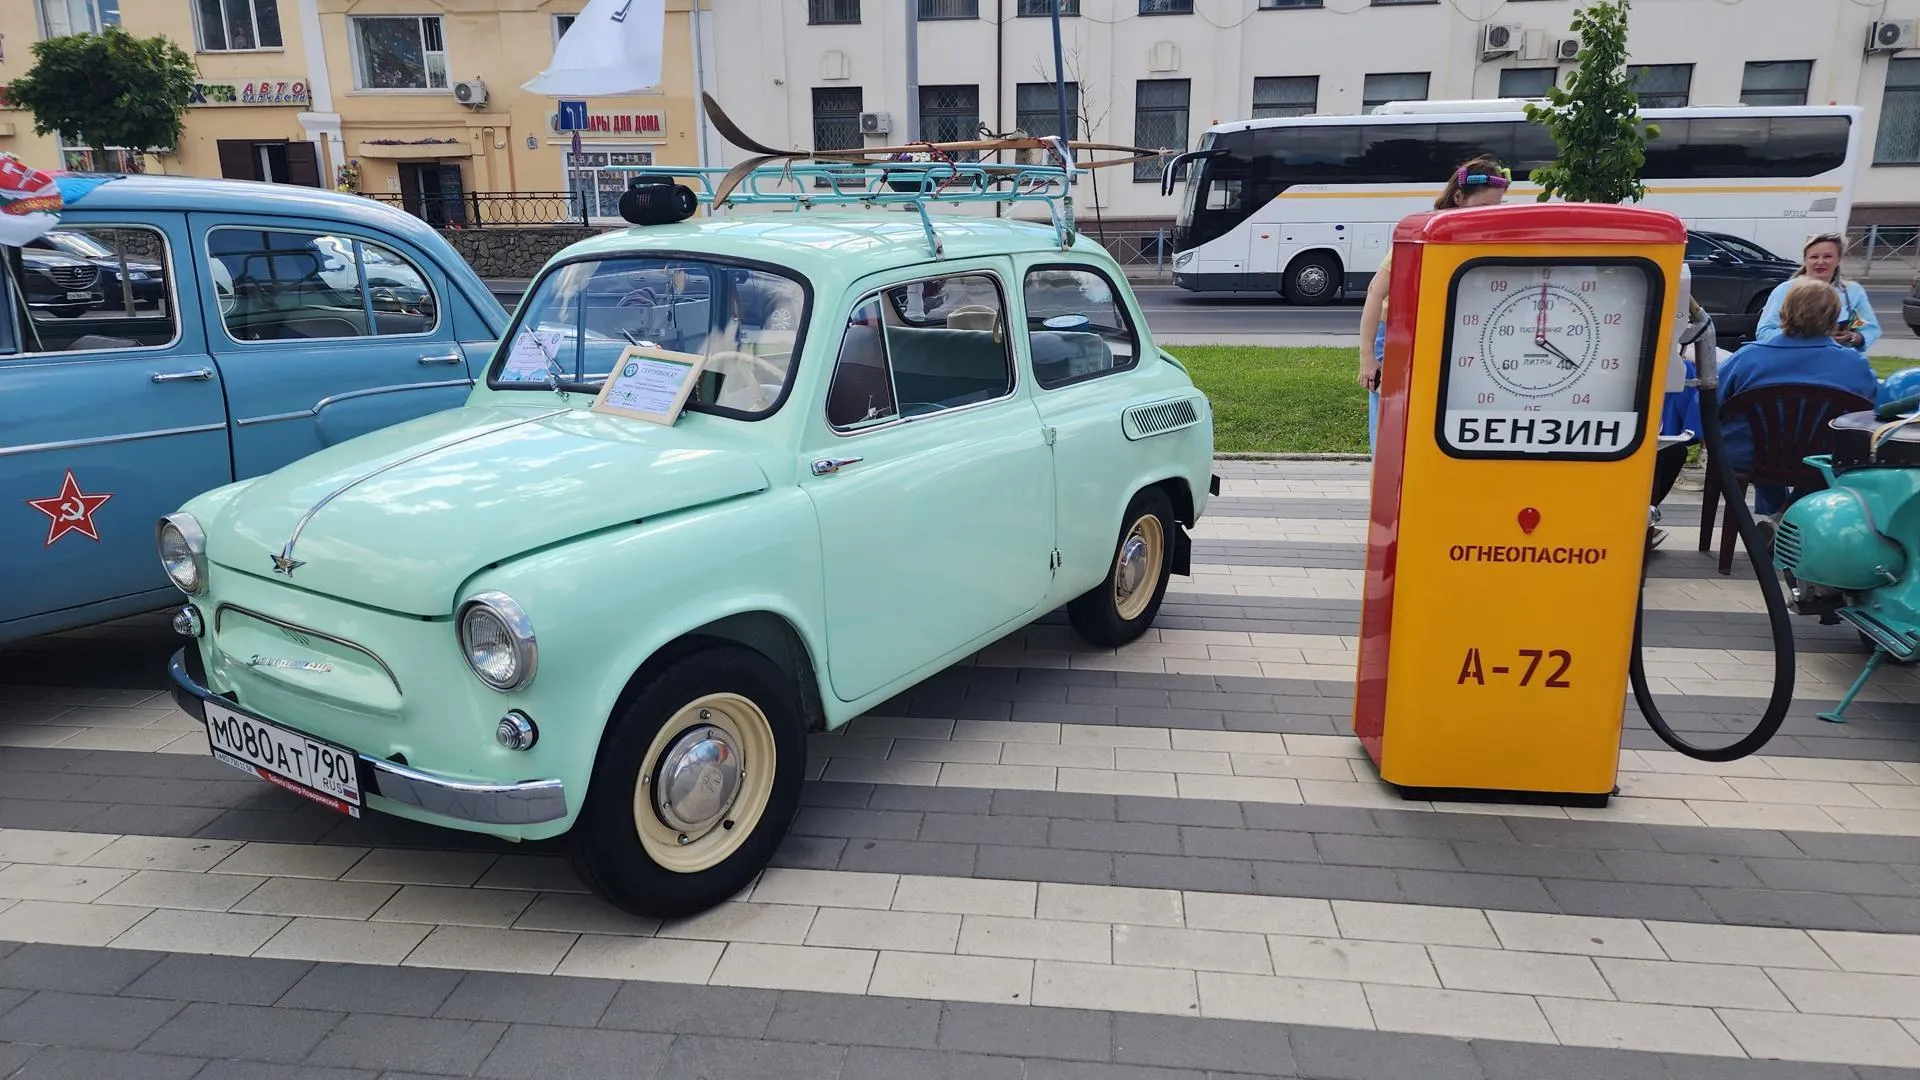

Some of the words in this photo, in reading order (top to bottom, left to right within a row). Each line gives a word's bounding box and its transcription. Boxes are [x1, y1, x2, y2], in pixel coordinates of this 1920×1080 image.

[242, 82, 305, 95] АВТО
[241, 94, 306, 103] ЗАПЧАСТИ
[587, 115, 611, 132] АРЫ
[613, 115, 632, 134] ДЛЯ
[635, 115, 660, 134] ДОМА
[1490, 280, 1508, 292] 09
[1581, 280, 1597, 292] 01
[1532, 300, 1554, 312] 100
[1462, 314, 1479, 326] 08
[1604, 313, 1622, 326] 02
[1498, 324, 1515, 337] 80
[1566, 324, 1584, 337] 20
[1458, 356, 1475, 368] 07
[1502, 360, 1519, 372] 60
[1523, 357, 1553, 367] ЛИТРЫ
[1556, 360, 1573, 372] 40
[1601, 357, 1619, 370] 03
[1477, 392, 1495, 404] 06
[1572, 393, 1591, 405] 04
[1458, 418, 1621, 447] БЕНЗИН
[1457, 648, 1572, 688] А-72
[213, 716, 302, 777] М080АТ
[307, 743, 349, 784] 790
[322, 777, 343, 794] RUS
